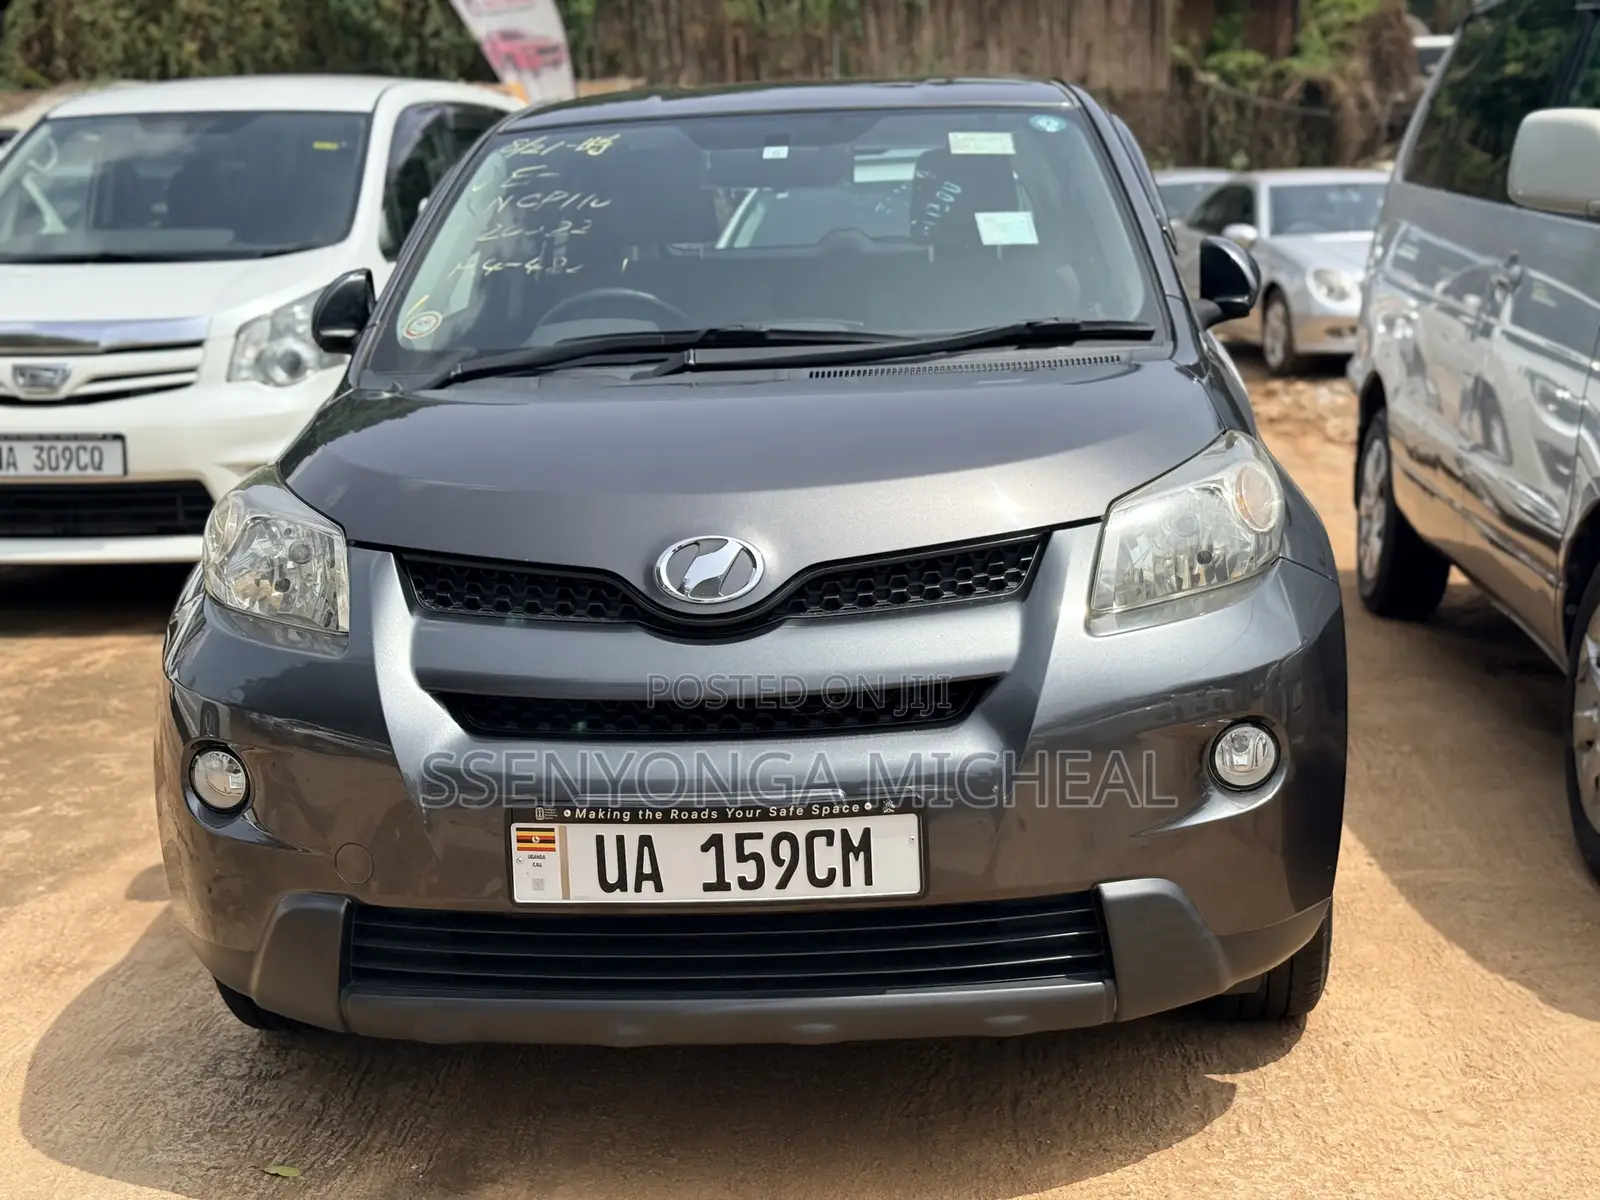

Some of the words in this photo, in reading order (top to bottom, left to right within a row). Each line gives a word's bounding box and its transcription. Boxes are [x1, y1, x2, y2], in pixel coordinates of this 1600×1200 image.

[32, 444, 104, 472] 309CQ
[575, 808, 631, 822] Making
[638, 808, 663, 820] the
[670, 809, 719, 820] Roads
[726, 808, 762, 819] Your
[768, 806, 804, 817] Safe
[811, 803, 859, 816] Space
[596, 834, 664, 893] UA
[700, 826, 874, 892] 159CM
